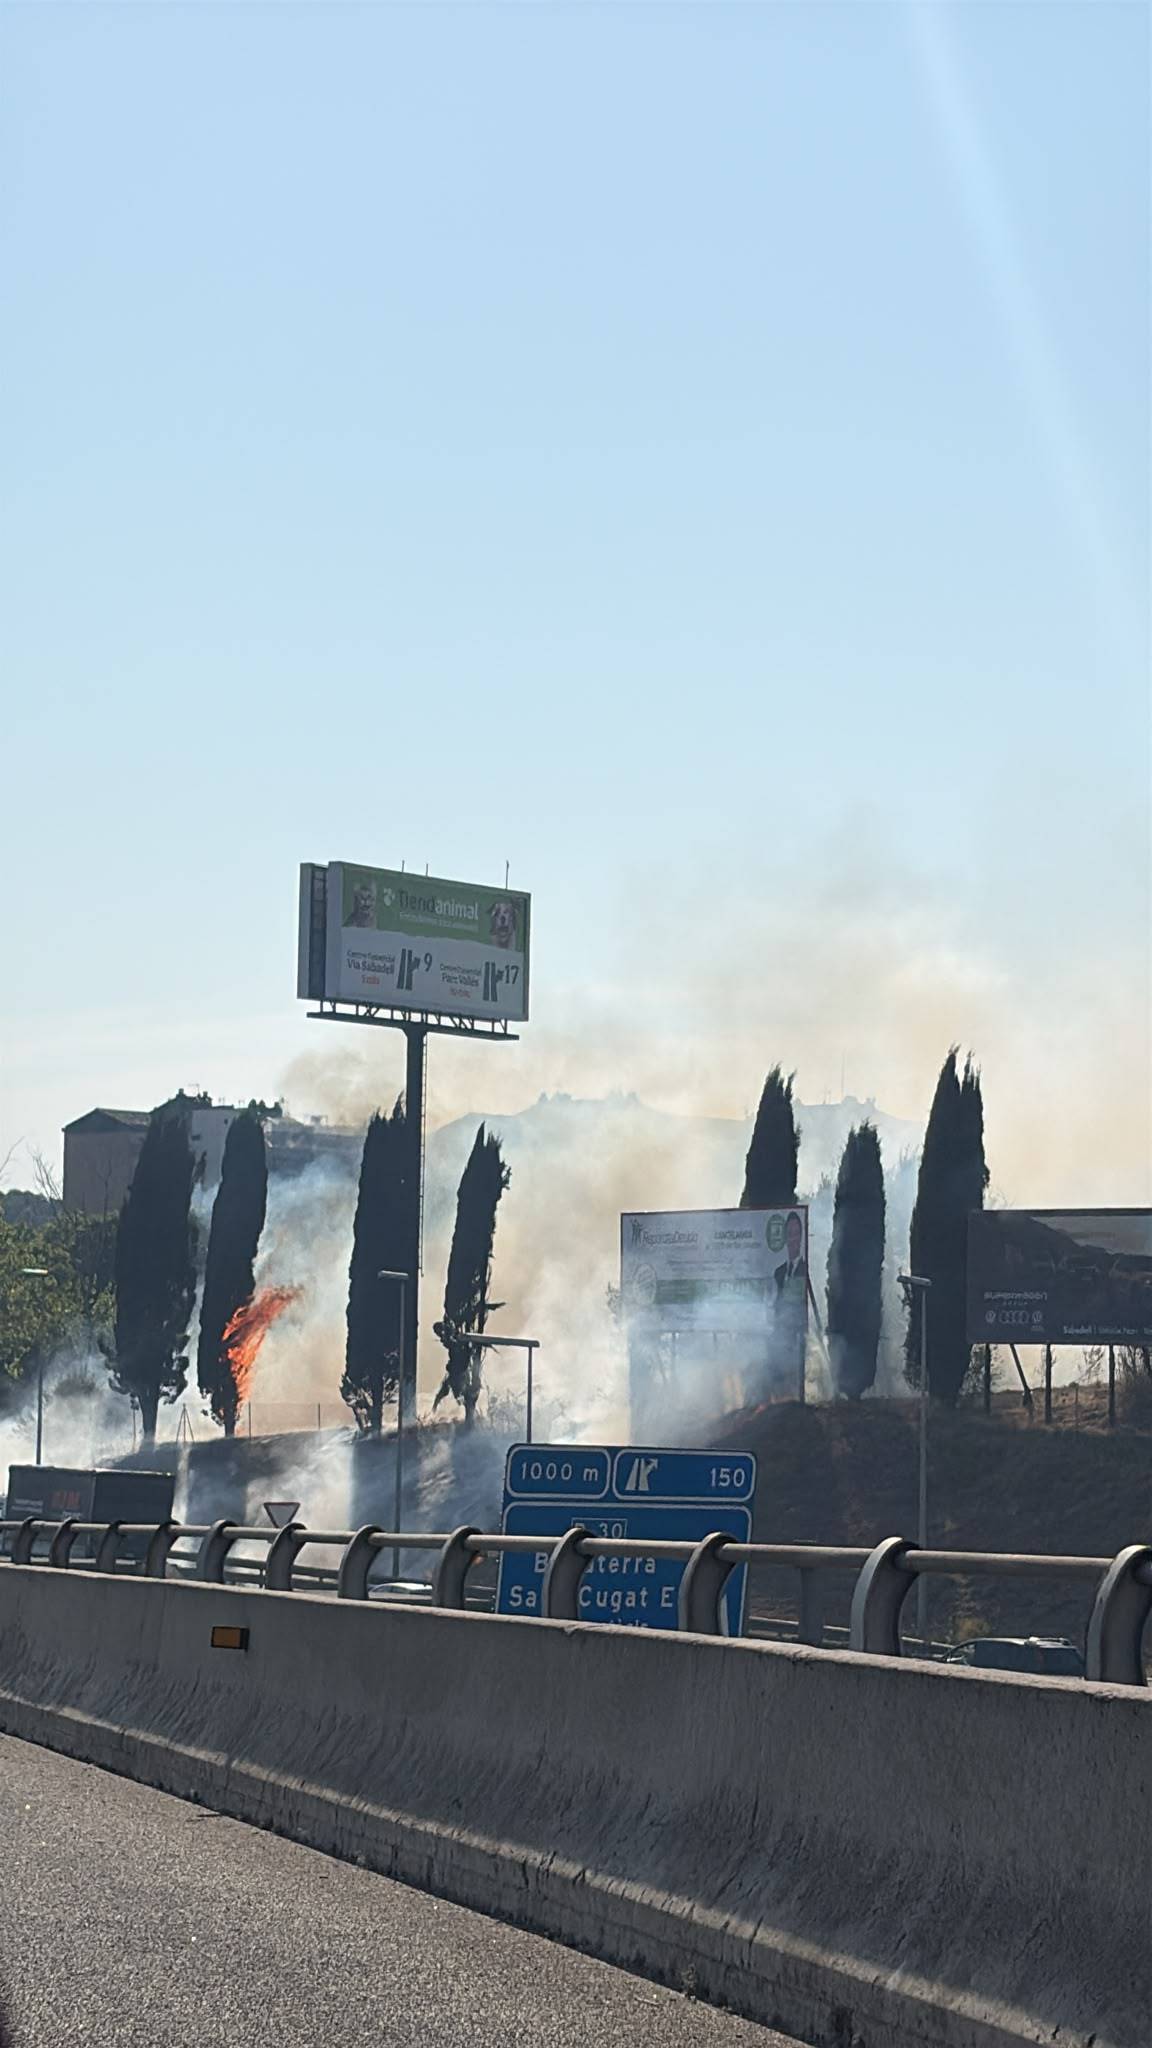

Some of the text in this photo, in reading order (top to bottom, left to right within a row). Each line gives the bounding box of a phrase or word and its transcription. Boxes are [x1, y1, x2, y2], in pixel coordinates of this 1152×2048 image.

[399, 889, 479, 920] Tiendanimal
[424, 952, 433, 973] 9
[505, 964, 520, 985] 17
[521, 1462, 599, 1483] 1000 m
[710, 1467, 746, 1488] 150
[509, 1584, 537, 1608] Sa
[577, 1585, 649, 1614] Cugat
